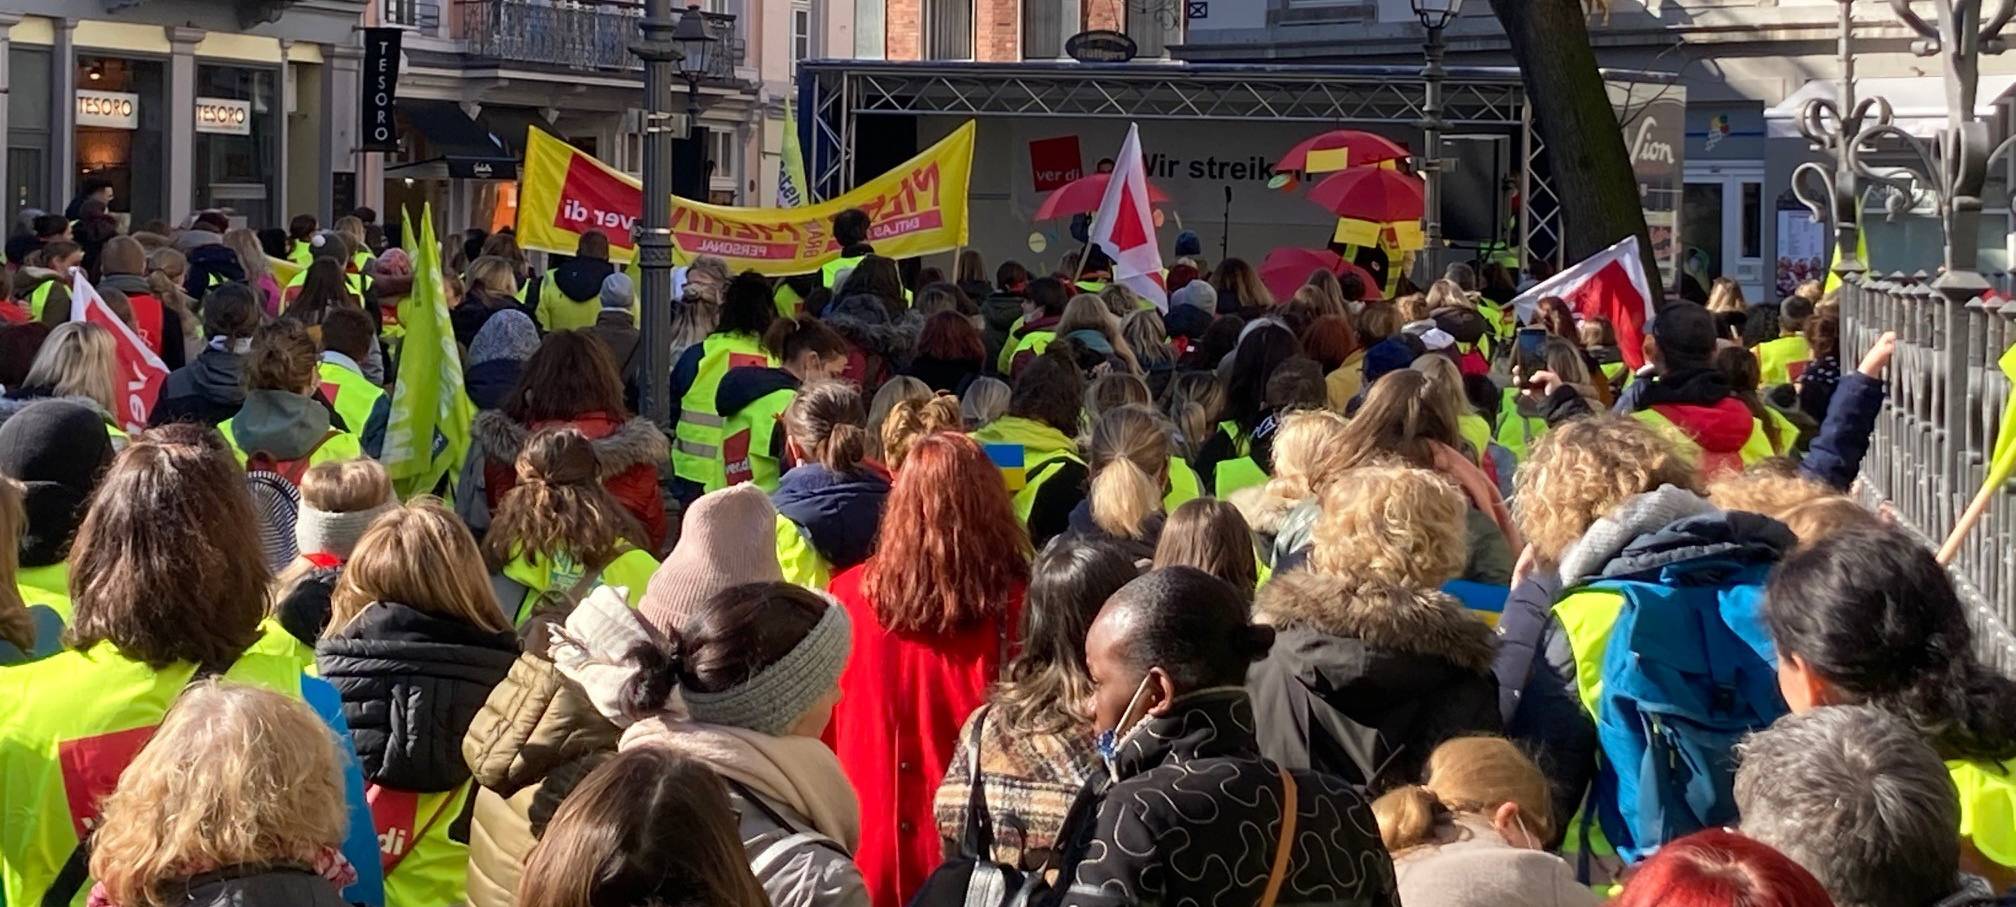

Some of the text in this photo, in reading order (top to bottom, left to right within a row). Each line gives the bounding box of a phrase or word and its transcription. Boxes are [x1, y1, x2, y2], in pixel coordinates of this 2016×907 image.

[374, 41, 389, 140] TESORO
[77, 96, 133, 117] TESORO
[195, 104, 246, 125] TESORO
[1188, 156, 1312, 182] streik
